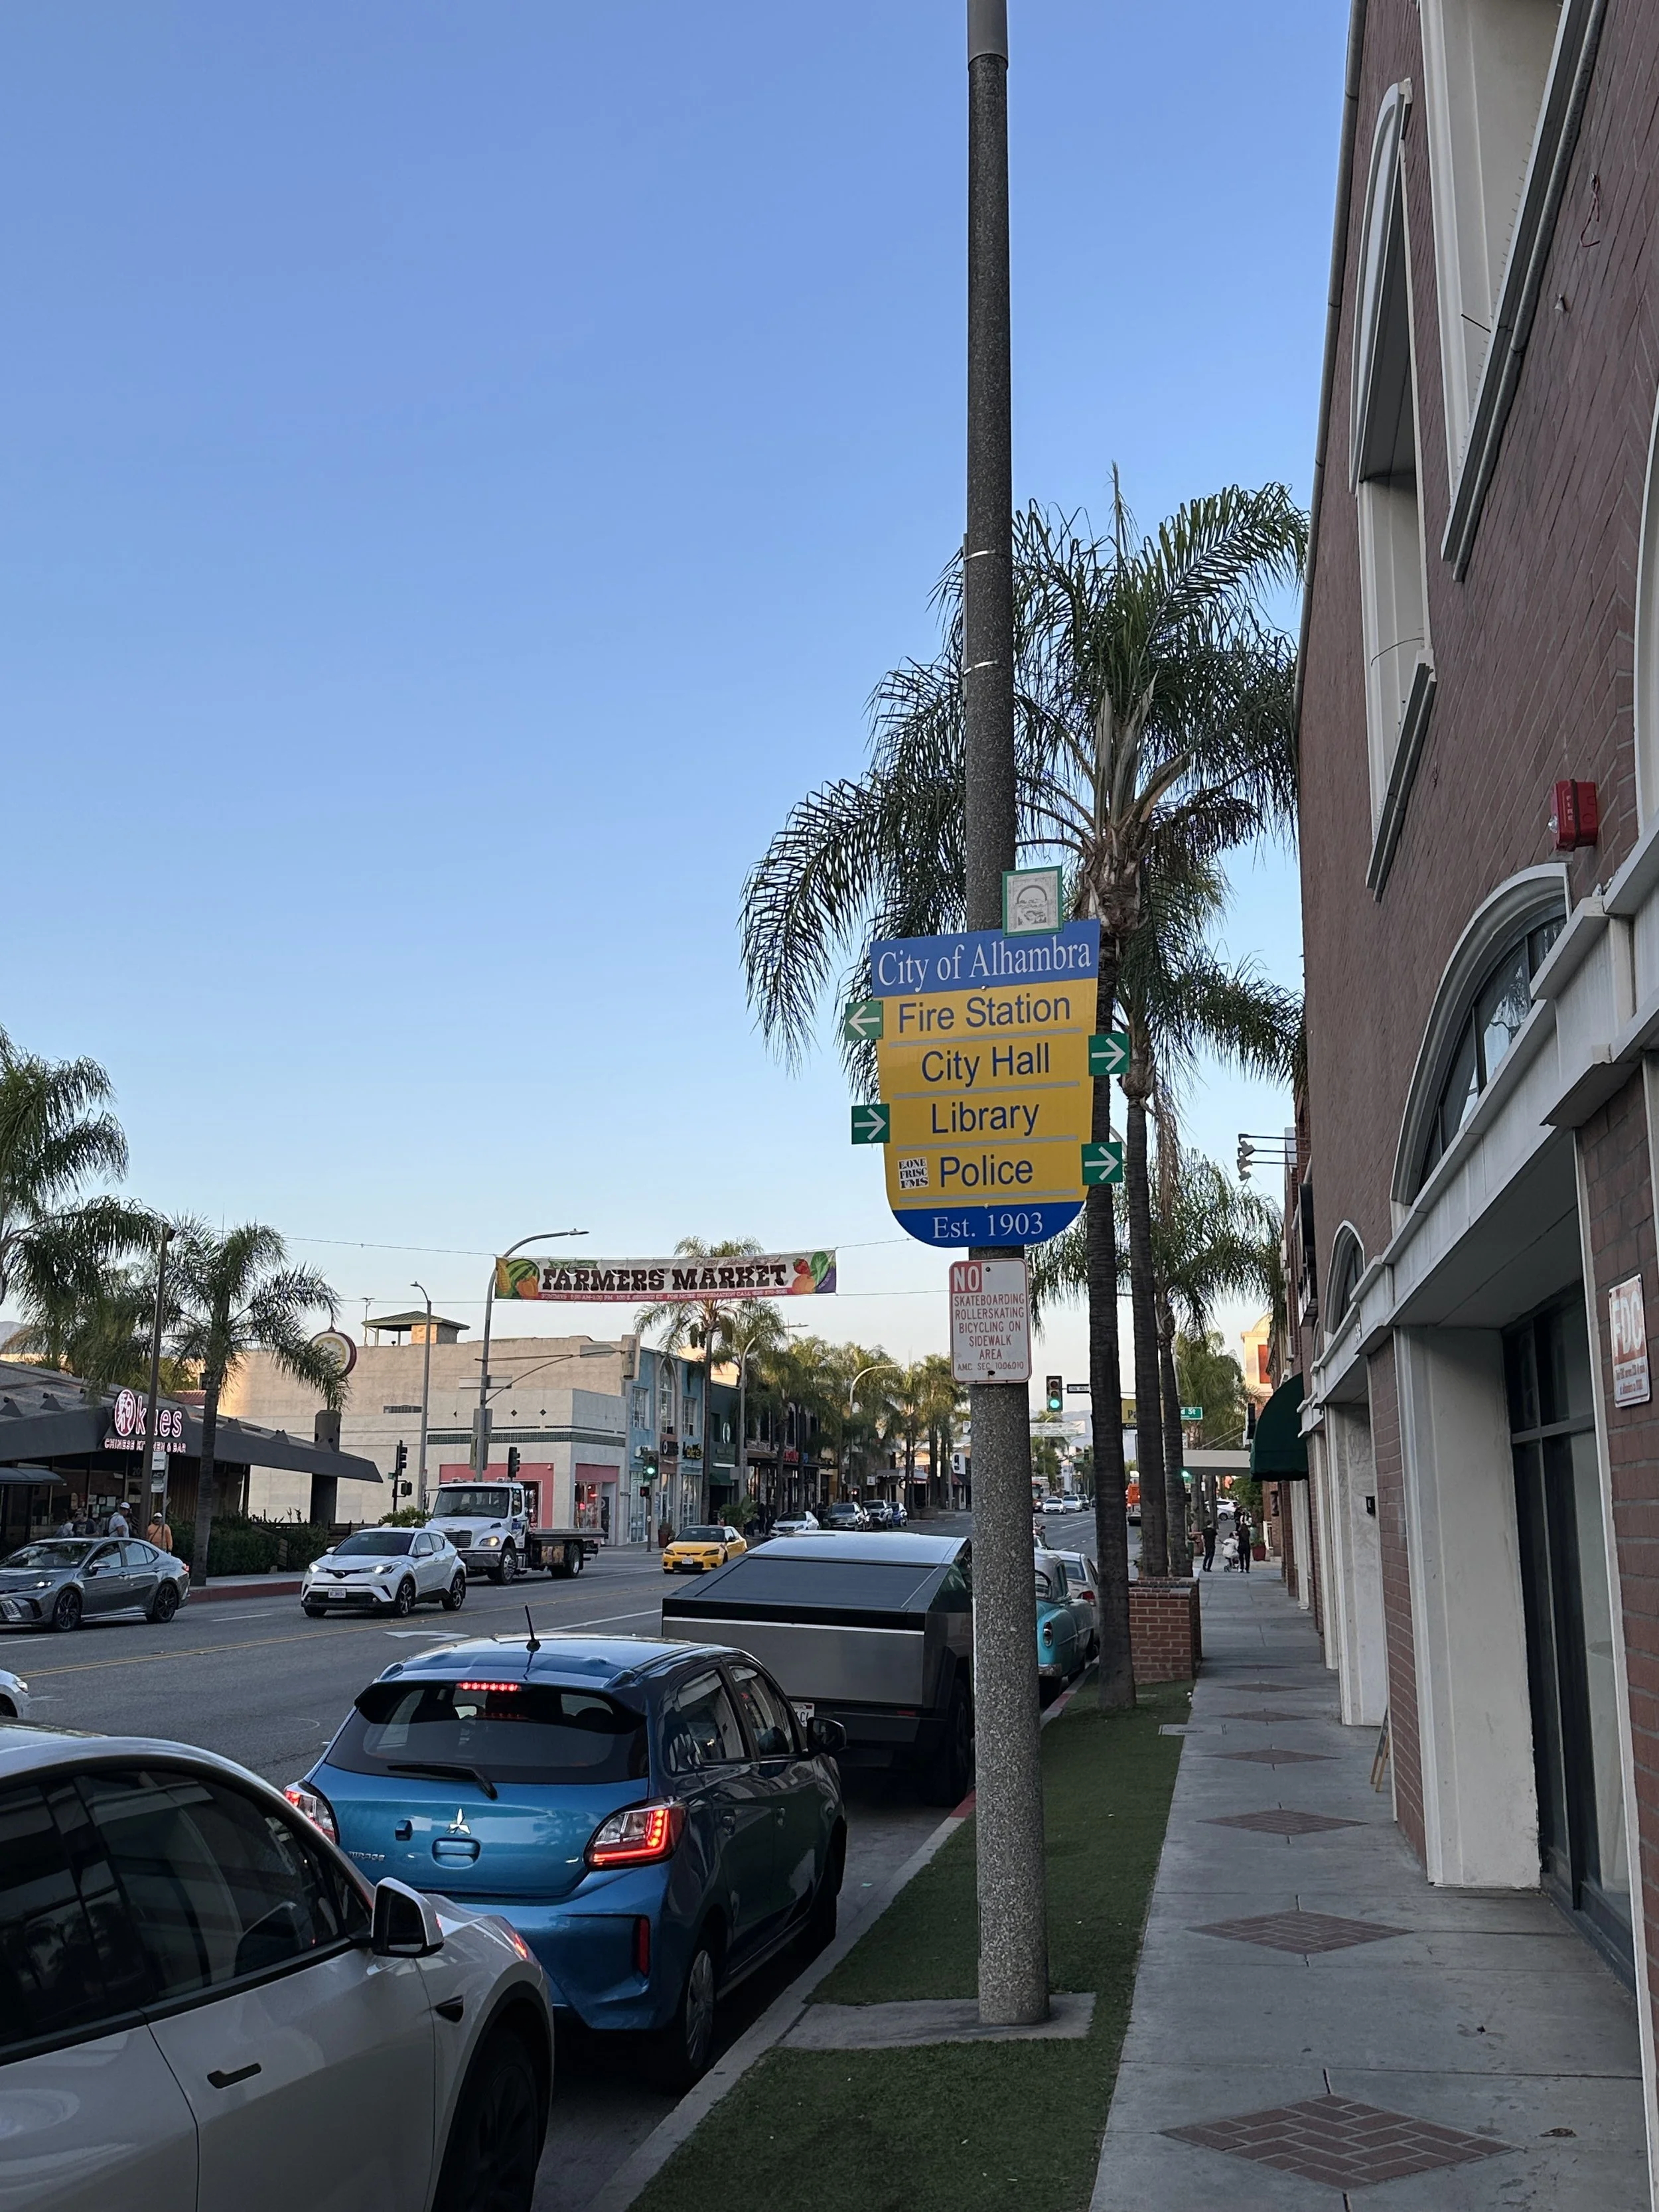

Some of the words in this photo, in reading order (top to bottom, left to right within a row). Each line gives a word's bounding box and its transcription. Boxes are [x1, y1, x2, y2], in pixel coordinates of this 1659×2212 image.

[878, 949, 930, 993] City
[936, 944, 965, 981] of
[968, 935, 1092, 978] Alhambra
[899, 1001, 954, 1033] Fire
[966, 993, 1070, 1027] Station
[922, 1050, 980, 1088] City
[992, 1042, 1049, 1077] Hall
[932, 1101, 1039, 1136] Library
[940, 1154, 1033, 1187] Police
[932, 1217, 975, 1238] Est.
[987, 1212, 1043, 1236] 1903
[542, 1268, 665, 1291] FARMERS
[672, 1264, 786, 1290] MARKET
[954, 1266, 979, 1291] NO
[954, 1293, 1025, 1307] SKATEBOARDING
[956, 1307, 1024, 1320] ROLLERSKATING
[1611, 1290, 1642, 1357] FDC
[959, 1321, 1004, 1333] BICYCLING
[1009, 1321, 1021, 1331] ON
[969, 1335, 1011, 1347] SIDEWALK
[979, 1349, 1002, 1360] AREA
[104, 1438, 135, 1450] CHINESE
[173, 1443, 186, 1453] BAR
